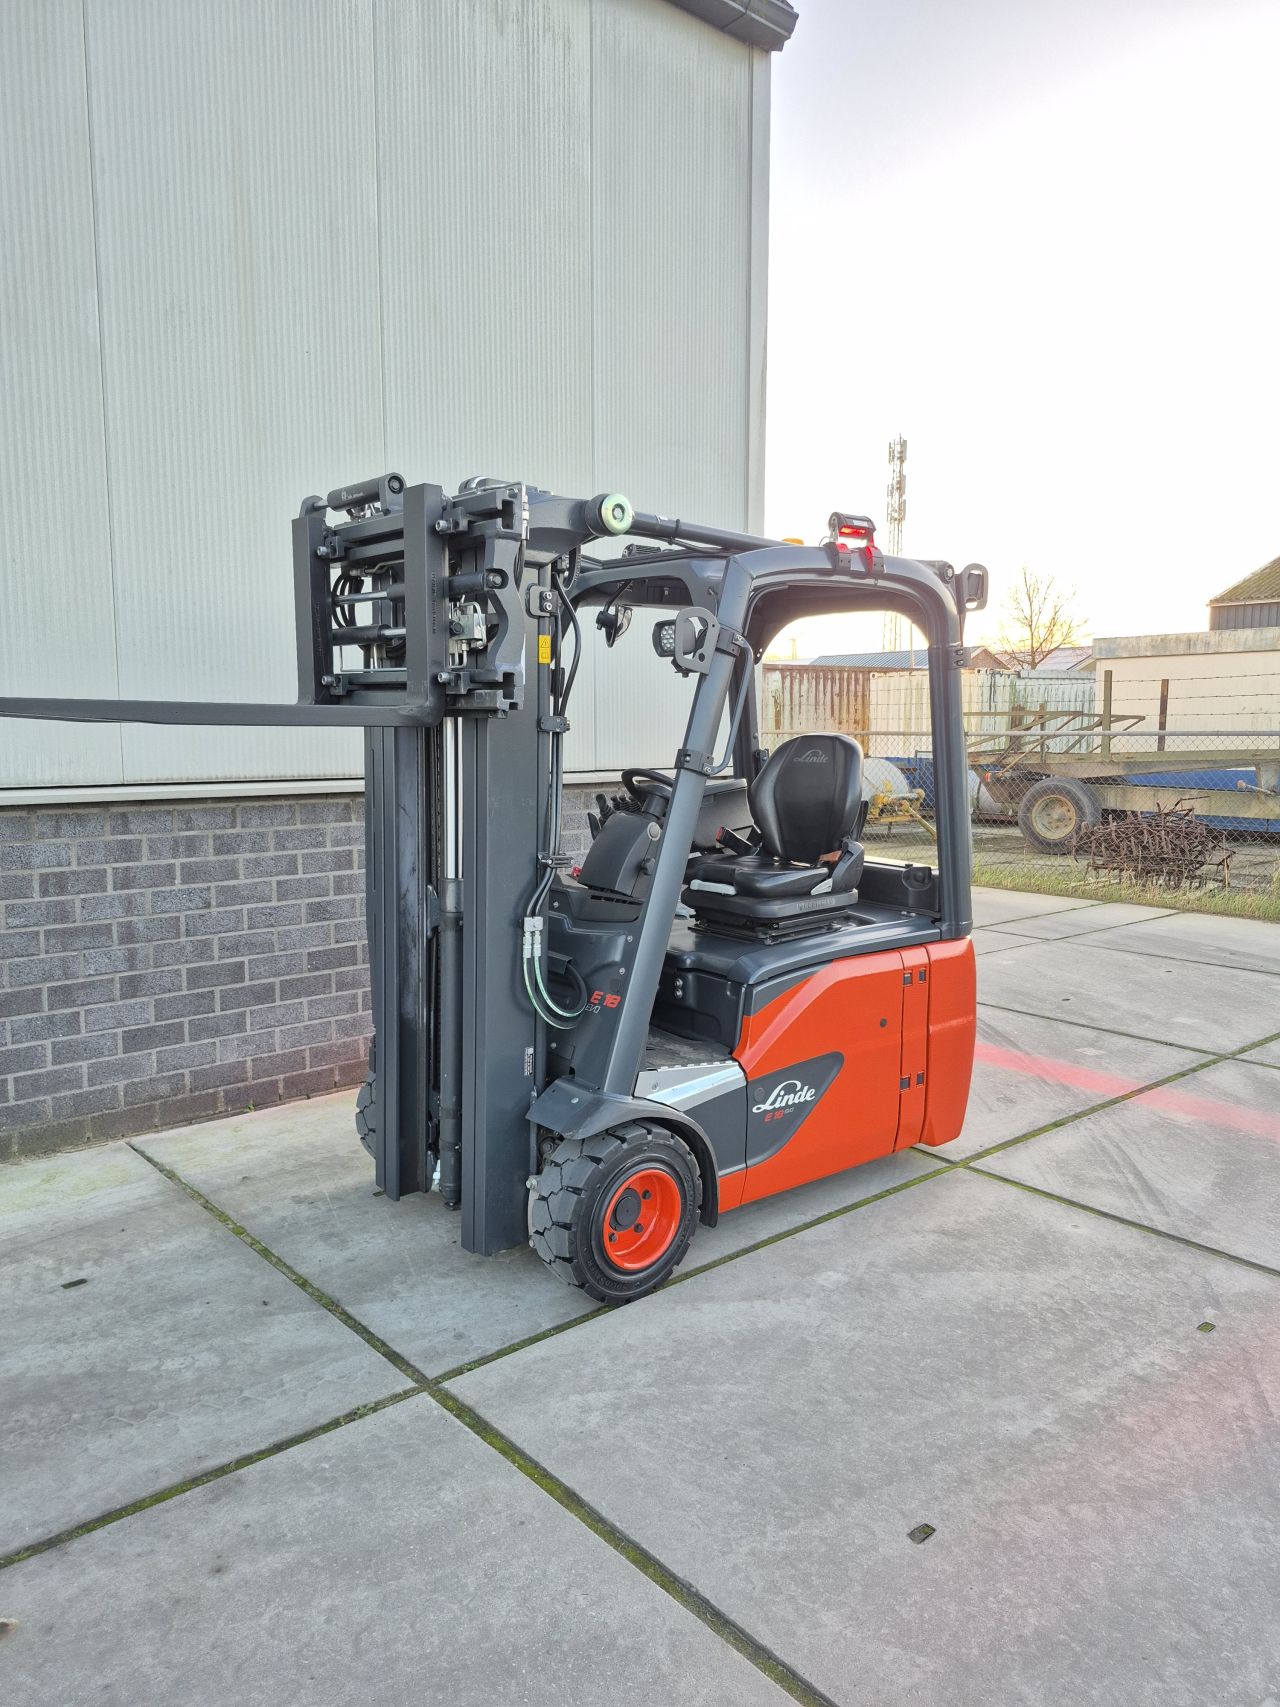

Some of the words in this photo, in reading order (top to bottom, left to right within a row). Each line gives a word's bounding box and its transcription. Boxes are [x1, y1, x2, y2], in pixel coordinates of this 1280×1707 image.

[793, 749, 829, 763] Linde
[590, 991, 604, 1004] E
[603, 994, 621, 1008] 18
[752, 1080, 816, 1113] Linde
